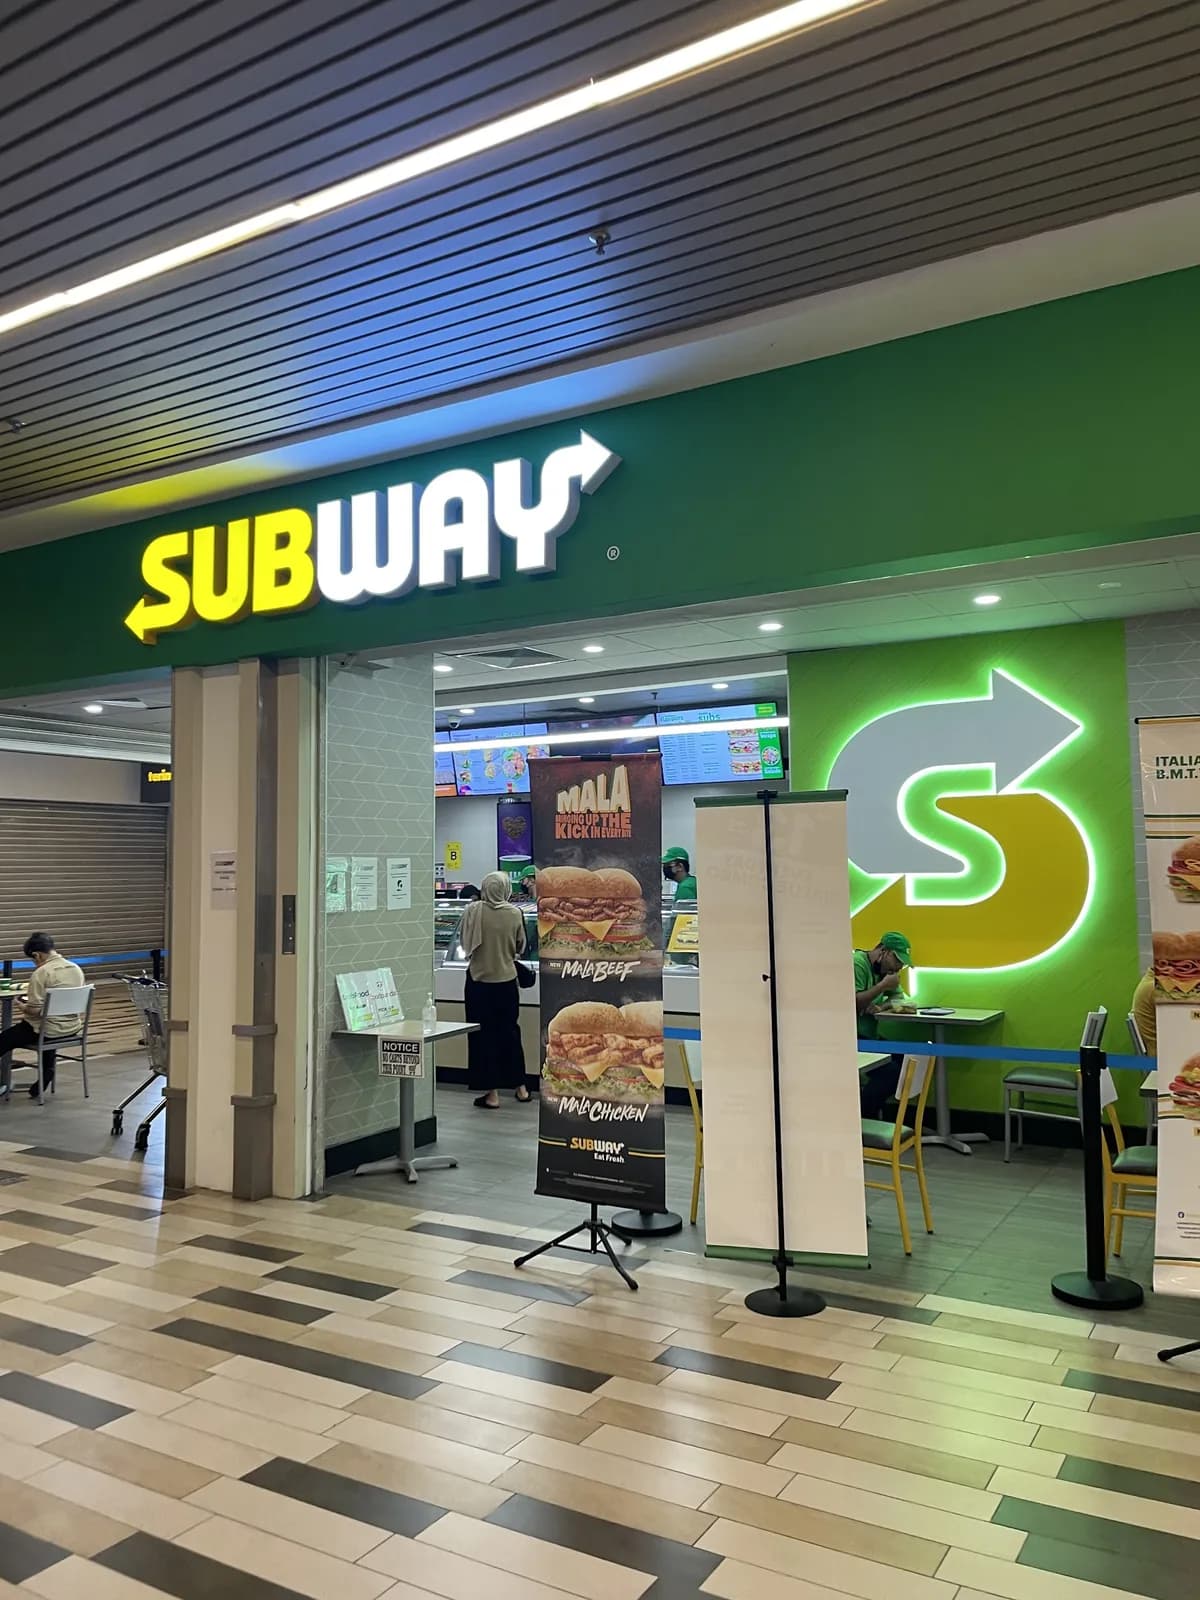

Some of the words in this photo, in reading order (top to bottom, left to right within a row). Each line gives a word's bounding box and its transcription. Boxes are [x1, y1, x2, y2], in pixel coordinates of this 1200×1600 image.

[124, 429, 617, 642] SUBWAY
[557, 764, 631, 813] MALA
[585, 813, 599, 826] UP
[601, 812, 632, 829] THE
[555, 823, 589, 839] KICK
[590, 826, 600, 838] IN
[593, 961, 640, 983] BEEF
[383, 1042, 418, 1053] NOTICE
[589, 1101, 649, 1122] CHICKEN
[570, 1137, 625, 1154] SUBWAY
[594, 1152, 605, 1161] Eat
[605, 1154, 625, 1163] Fresh
